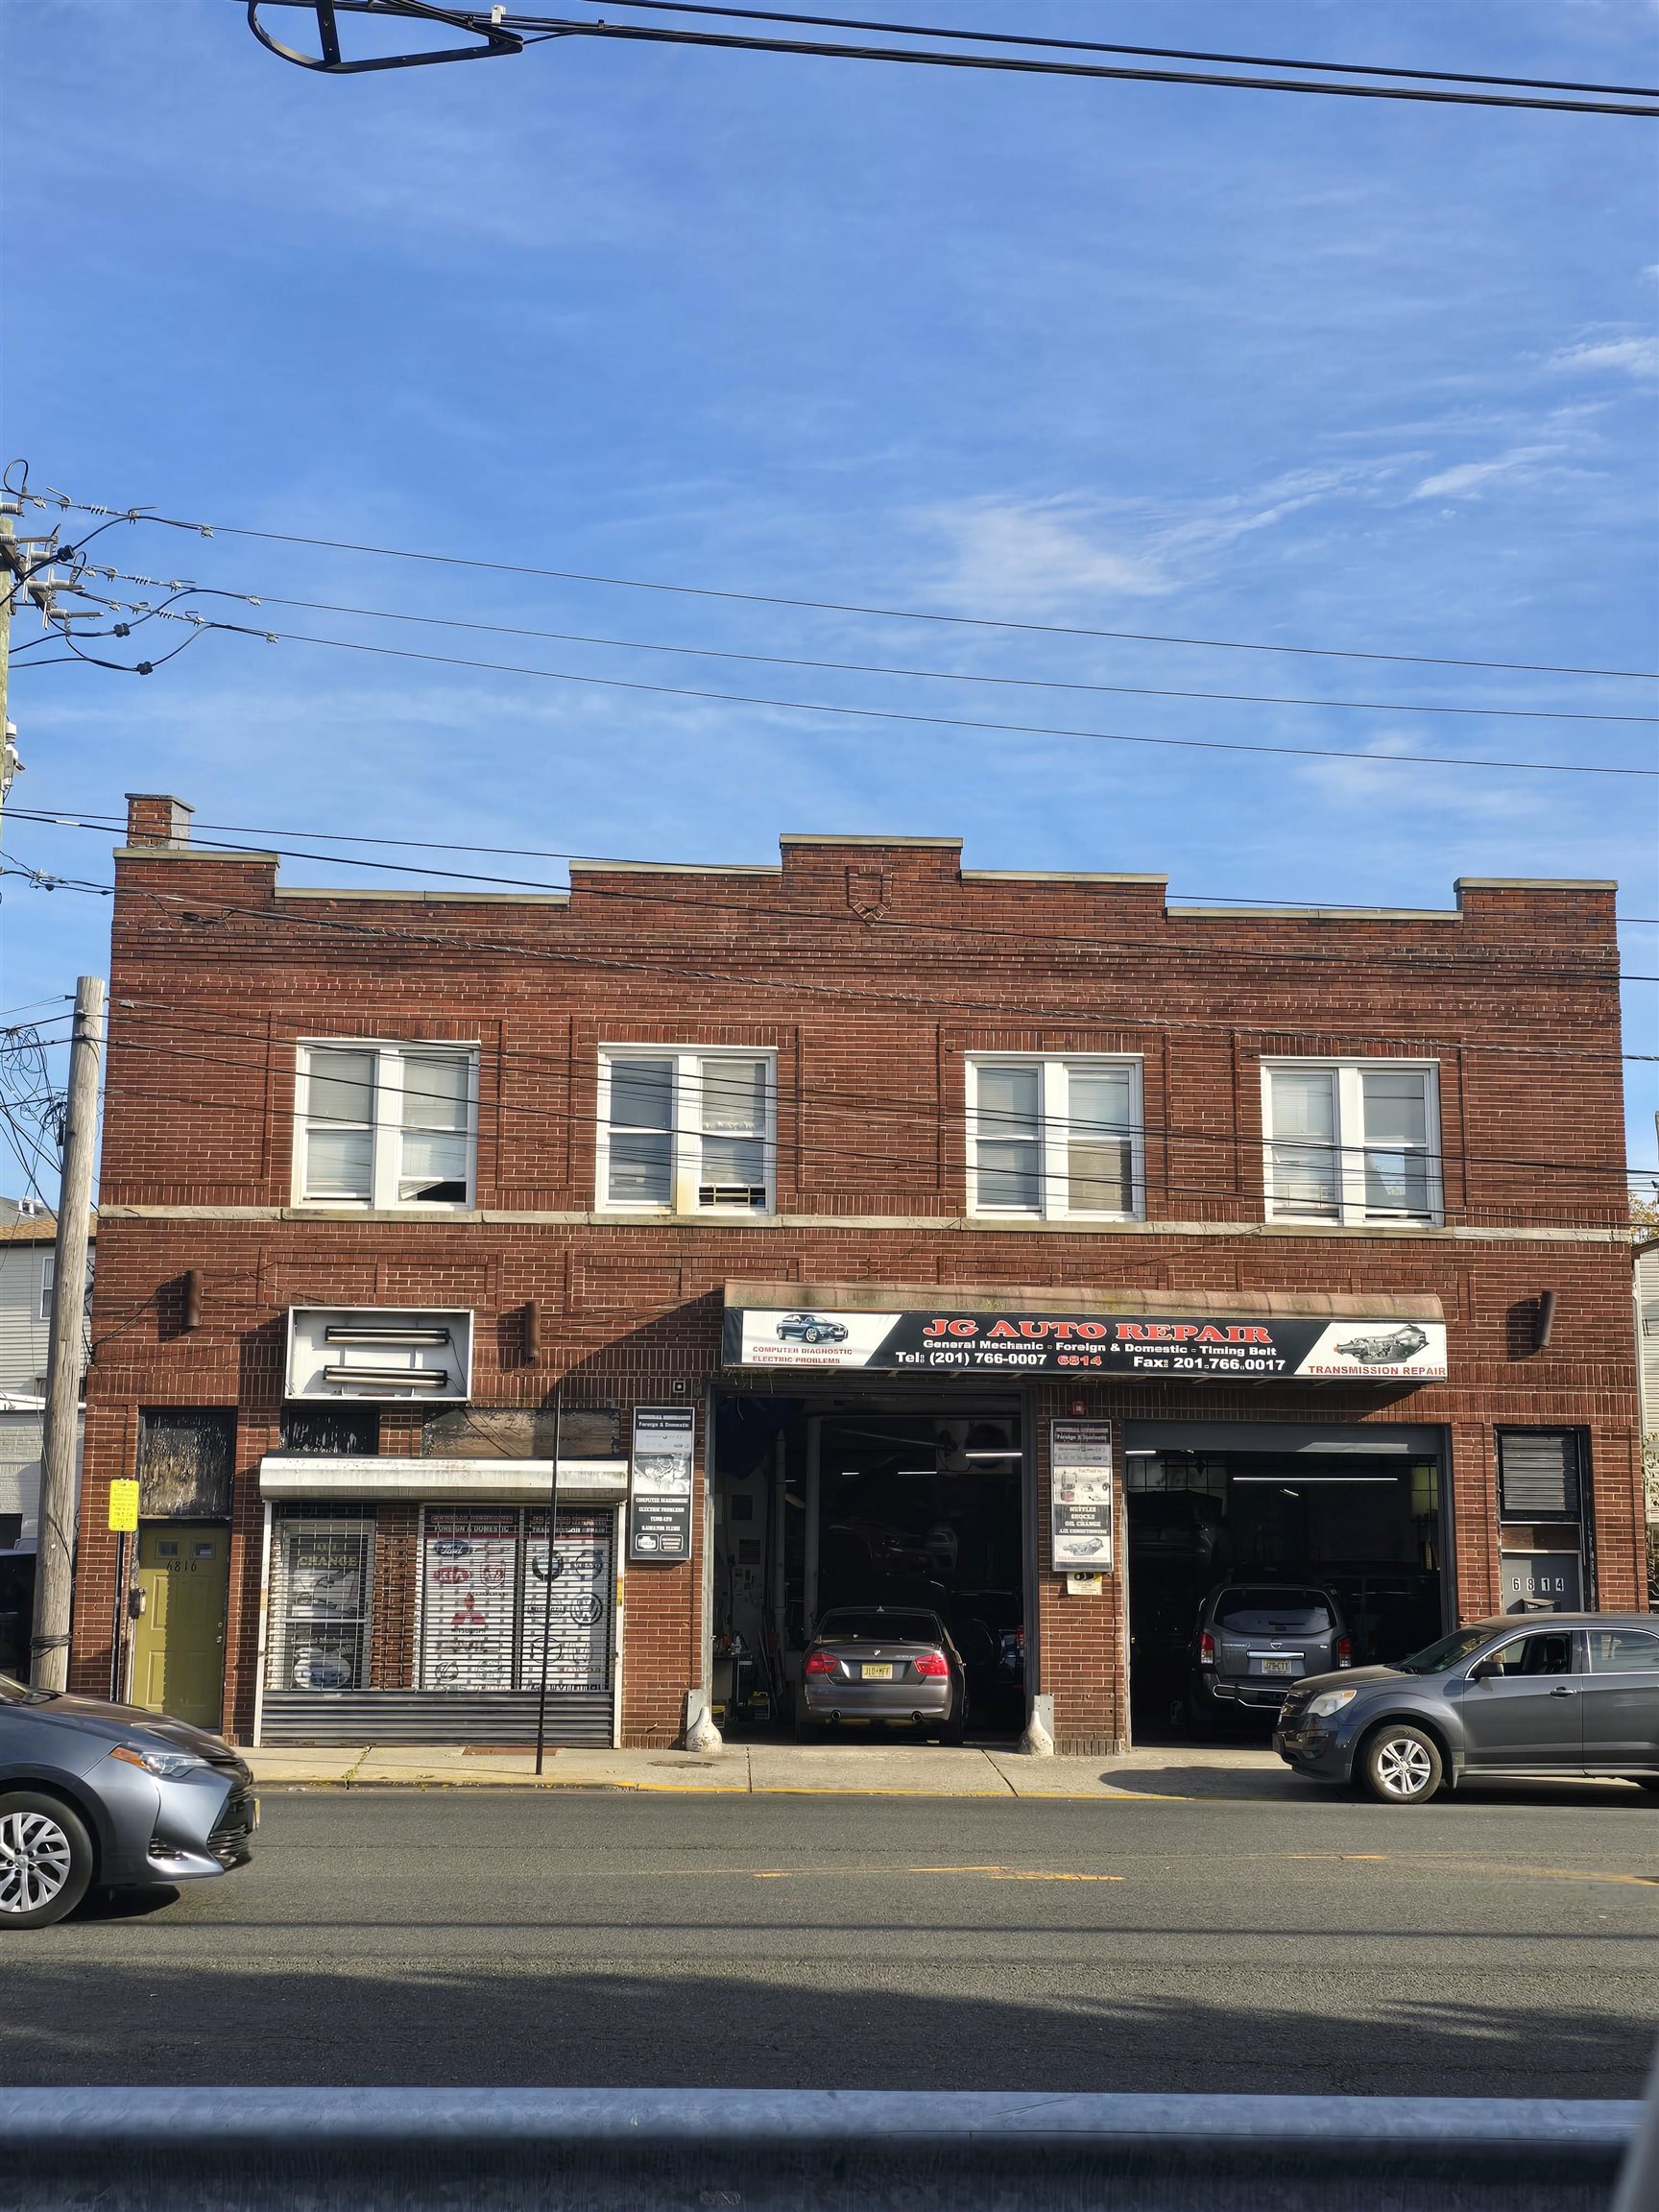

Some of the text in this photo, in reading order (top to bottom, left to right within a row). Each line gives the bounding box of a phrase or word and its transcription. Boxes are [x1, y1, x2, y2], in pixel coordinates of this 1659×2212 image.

[923, 1318, 1273, 1343] JG AUTO REPAIR
[753, 1346, 799, 1355] COMPUTER
[923, 1339, 975, 1349] General
[979, 1340, 1044, 1350] Mechanic
[1055, 1342, 1106, 1353] Foreign
[1110, 1343, 1120, 1352] &
[1124, 1344, 1188, 1354] Domestic
[1199, 1345, 1244, 1357] Timing
[1249, 1347, 1277, 1356] Belt
[753, 1355, 793, 1363] ELECTRIC
[896, 1352, 1286, 1371] Tel: (201) 766-0007 6814 Fax: 201.766.0017
[1308, 1365, 1446, 1376] TRANSMISSION REPAIR
[167, 1560, 197, 1573] 6816
[298, 1556, 357, 1567] CHANGE
[1513, 1578, 1563, 1591] 6814
